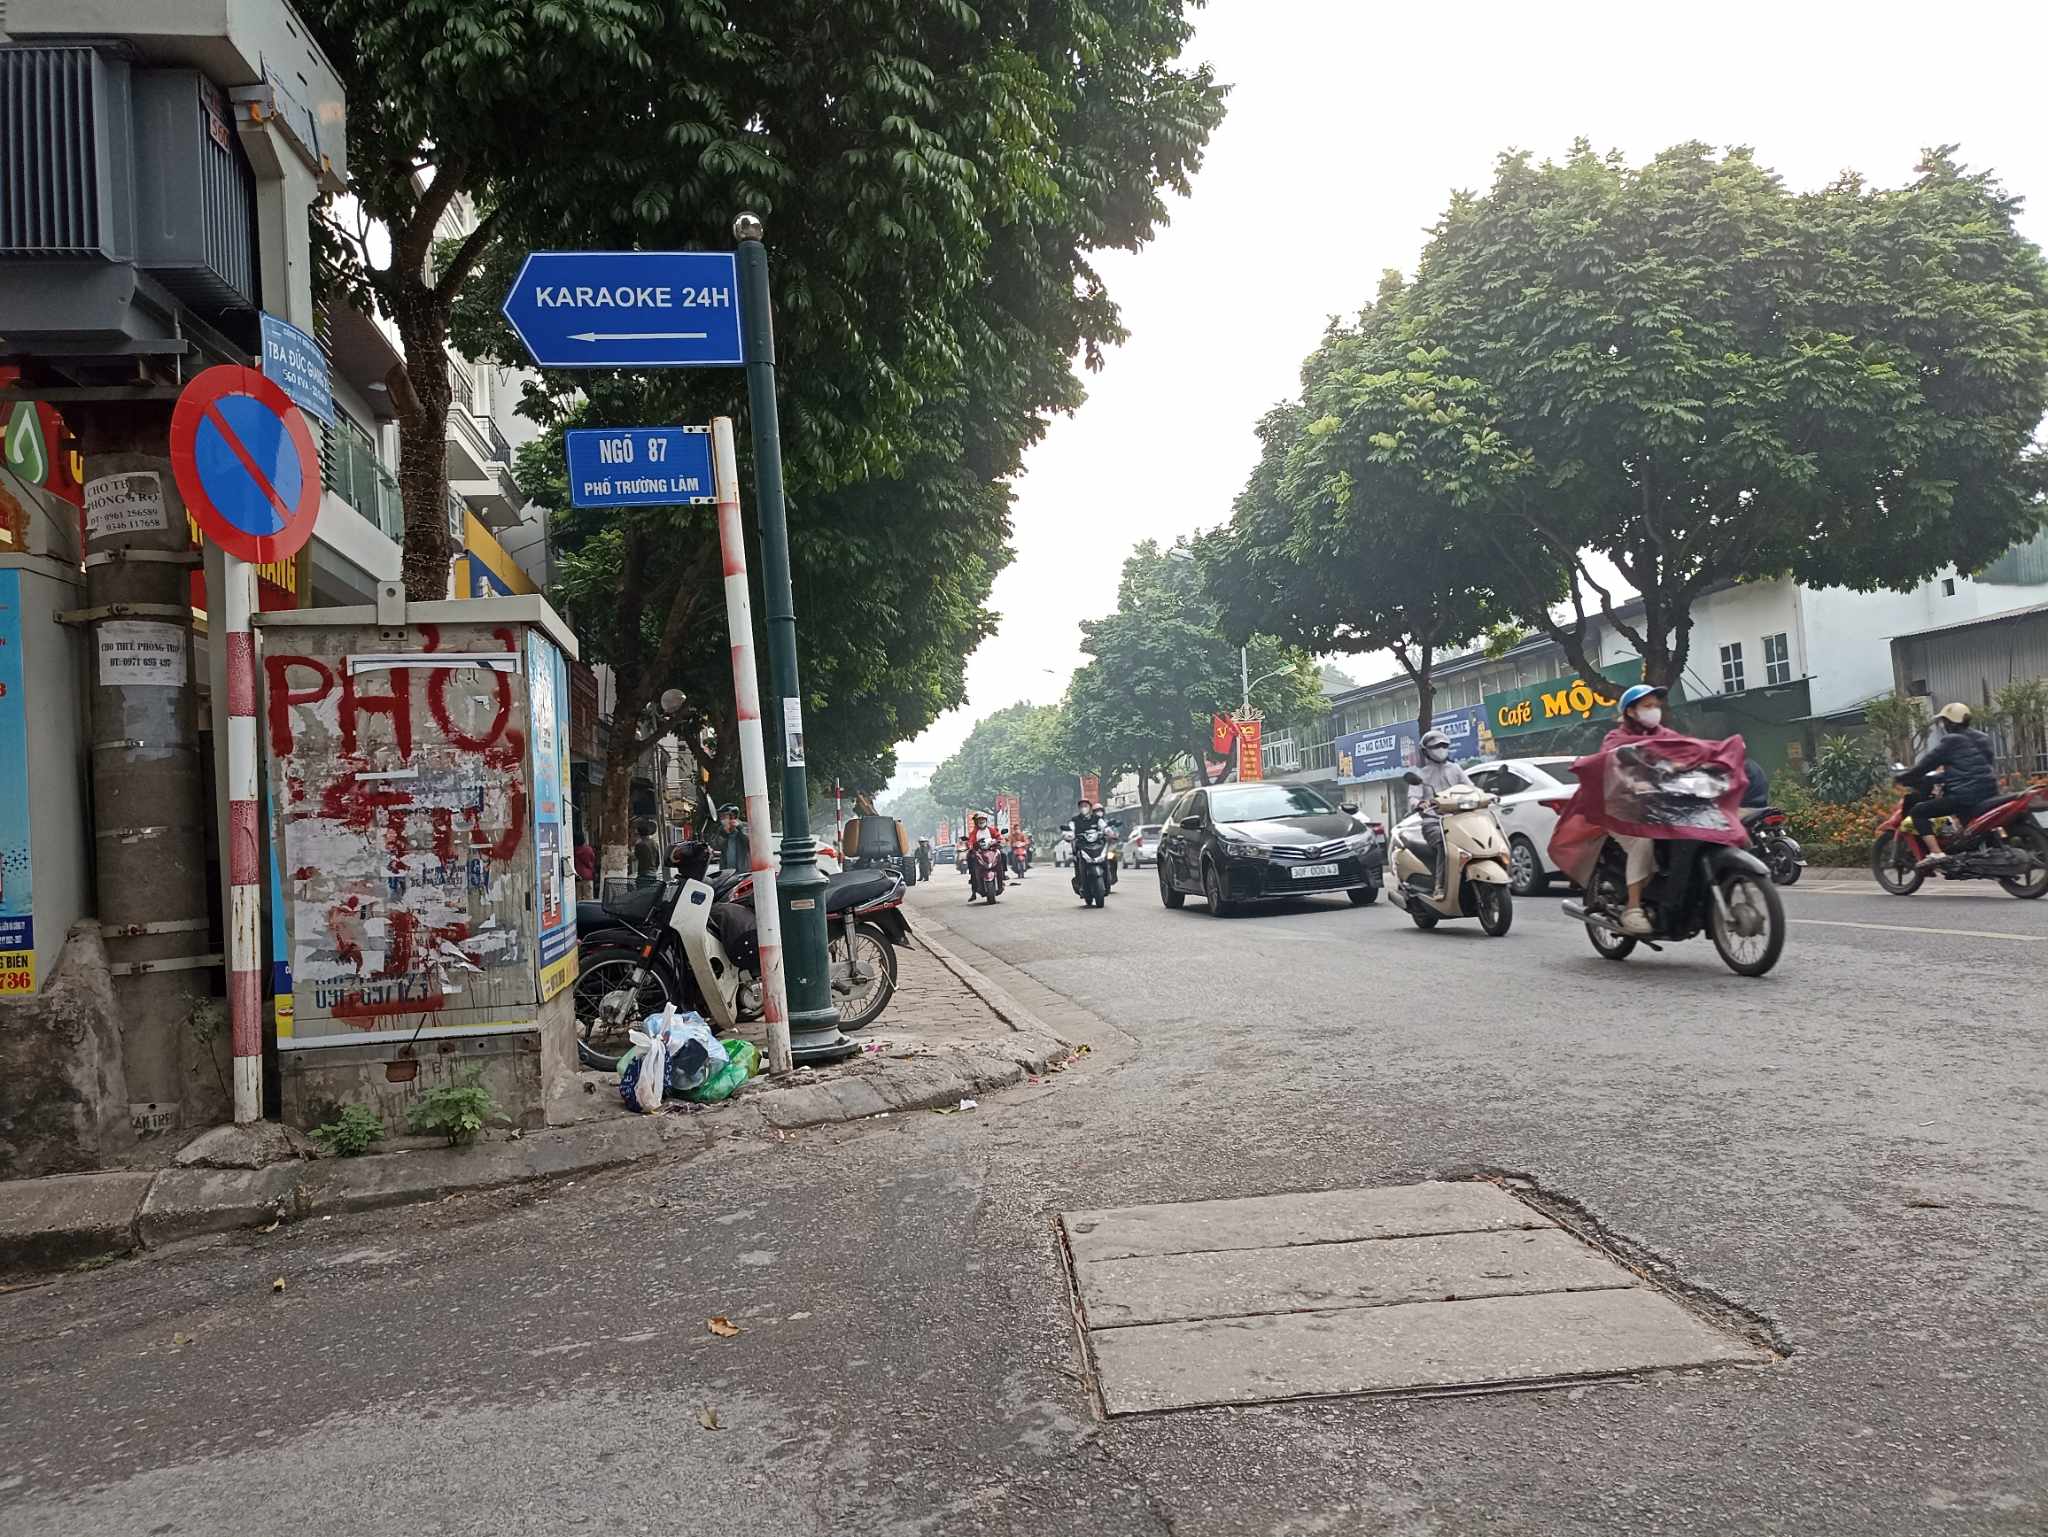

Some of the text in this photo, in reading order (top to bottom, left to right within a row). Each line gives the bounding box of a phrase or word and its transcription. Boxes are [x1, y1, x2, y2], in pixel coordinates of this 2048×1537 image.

[535, 286, 730, 308] KARAOKE 24H
[267, 341, 288, 363] TBA
[599, 434, 667, 464] NGÕ 87
[87, 483, 109, 498] CHO
[584, 474, 699, 496] PHỐ TRƯỜNG LÂM
[1498, 701, 1532, 727] Café
